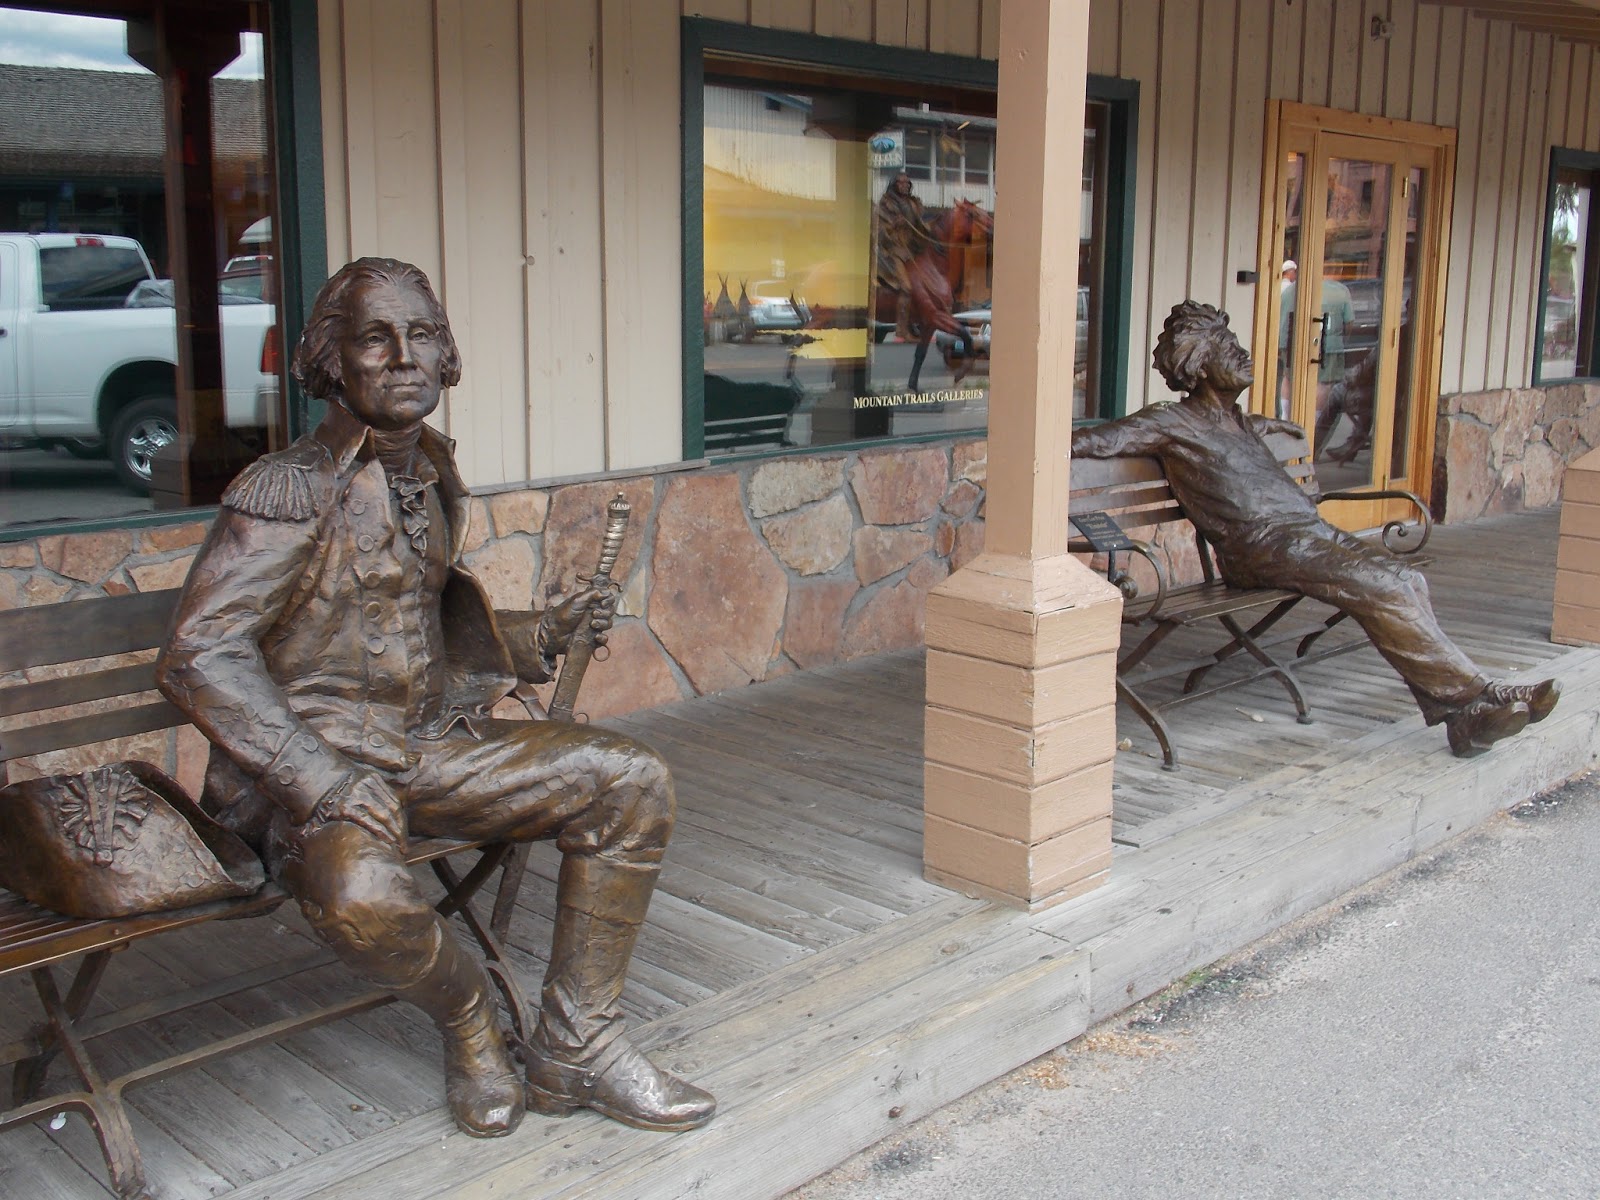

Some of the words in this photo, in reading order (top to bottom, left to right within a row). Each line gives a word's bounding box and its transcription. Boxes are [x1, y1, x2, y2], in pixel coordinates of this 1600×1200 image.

[853, 395, 903, 409] MOUNTAIN
[904, 392, 936, 404] TRAILS
[936, 389, 984, 402] GALLERIES
